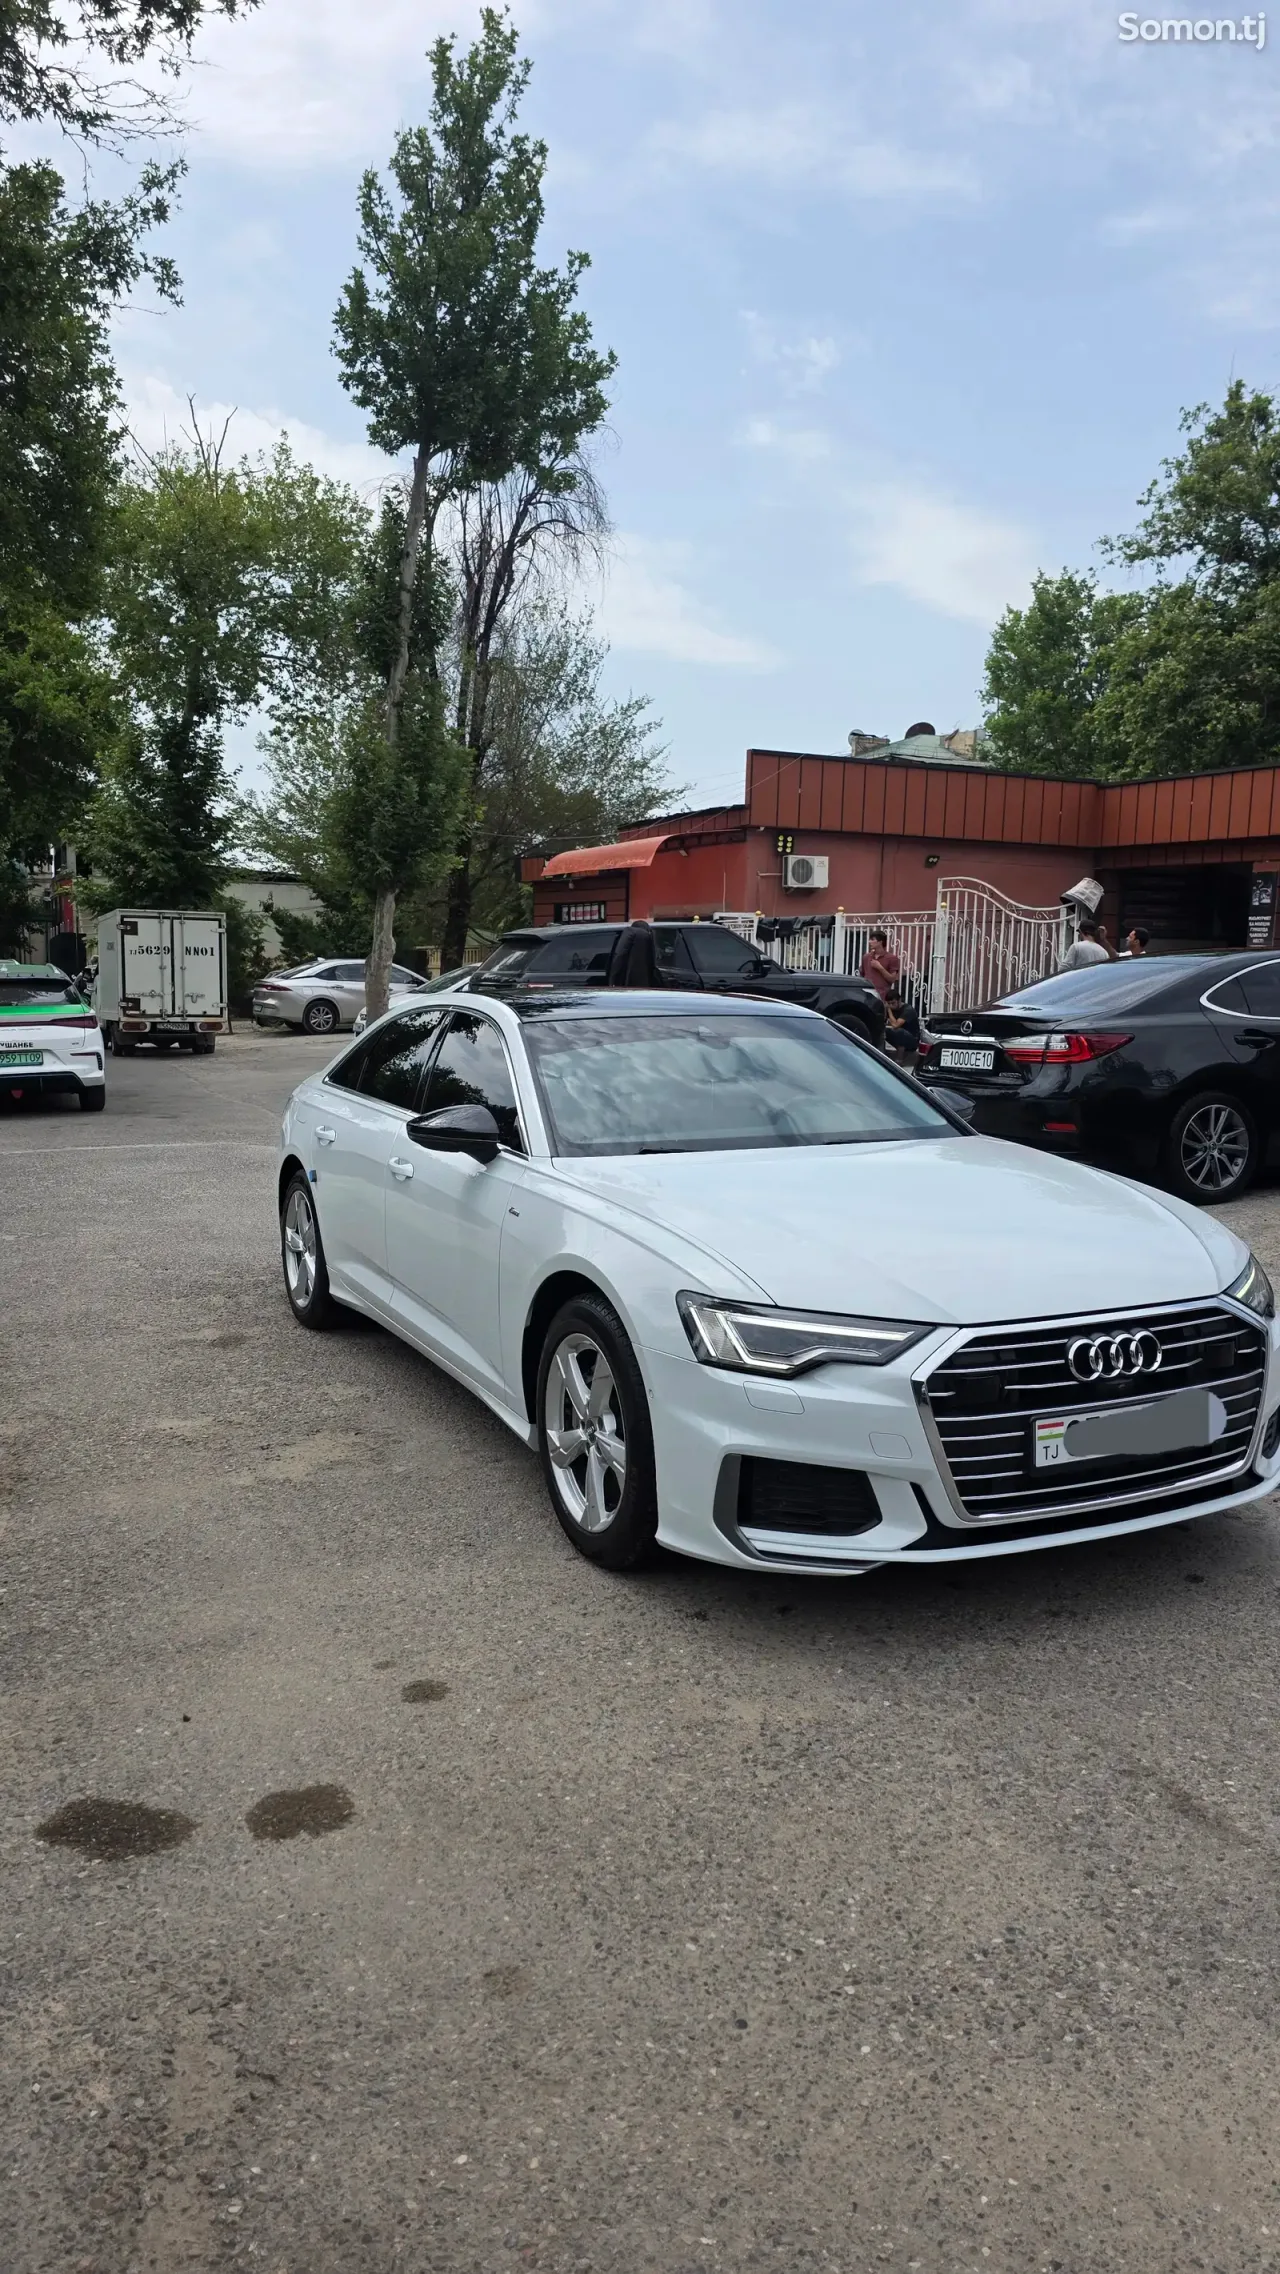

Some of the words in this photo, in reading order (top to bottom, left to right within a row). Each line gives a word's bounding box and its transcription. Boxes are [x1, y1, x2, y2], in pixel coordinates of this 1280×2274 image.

[138, 945, 171, 956] 5629
[185, 946, 215, 957] NN01
[950, 1050, 993, 1068] 1000CE10
[1043, 1444, 1059, 1460] TJ
